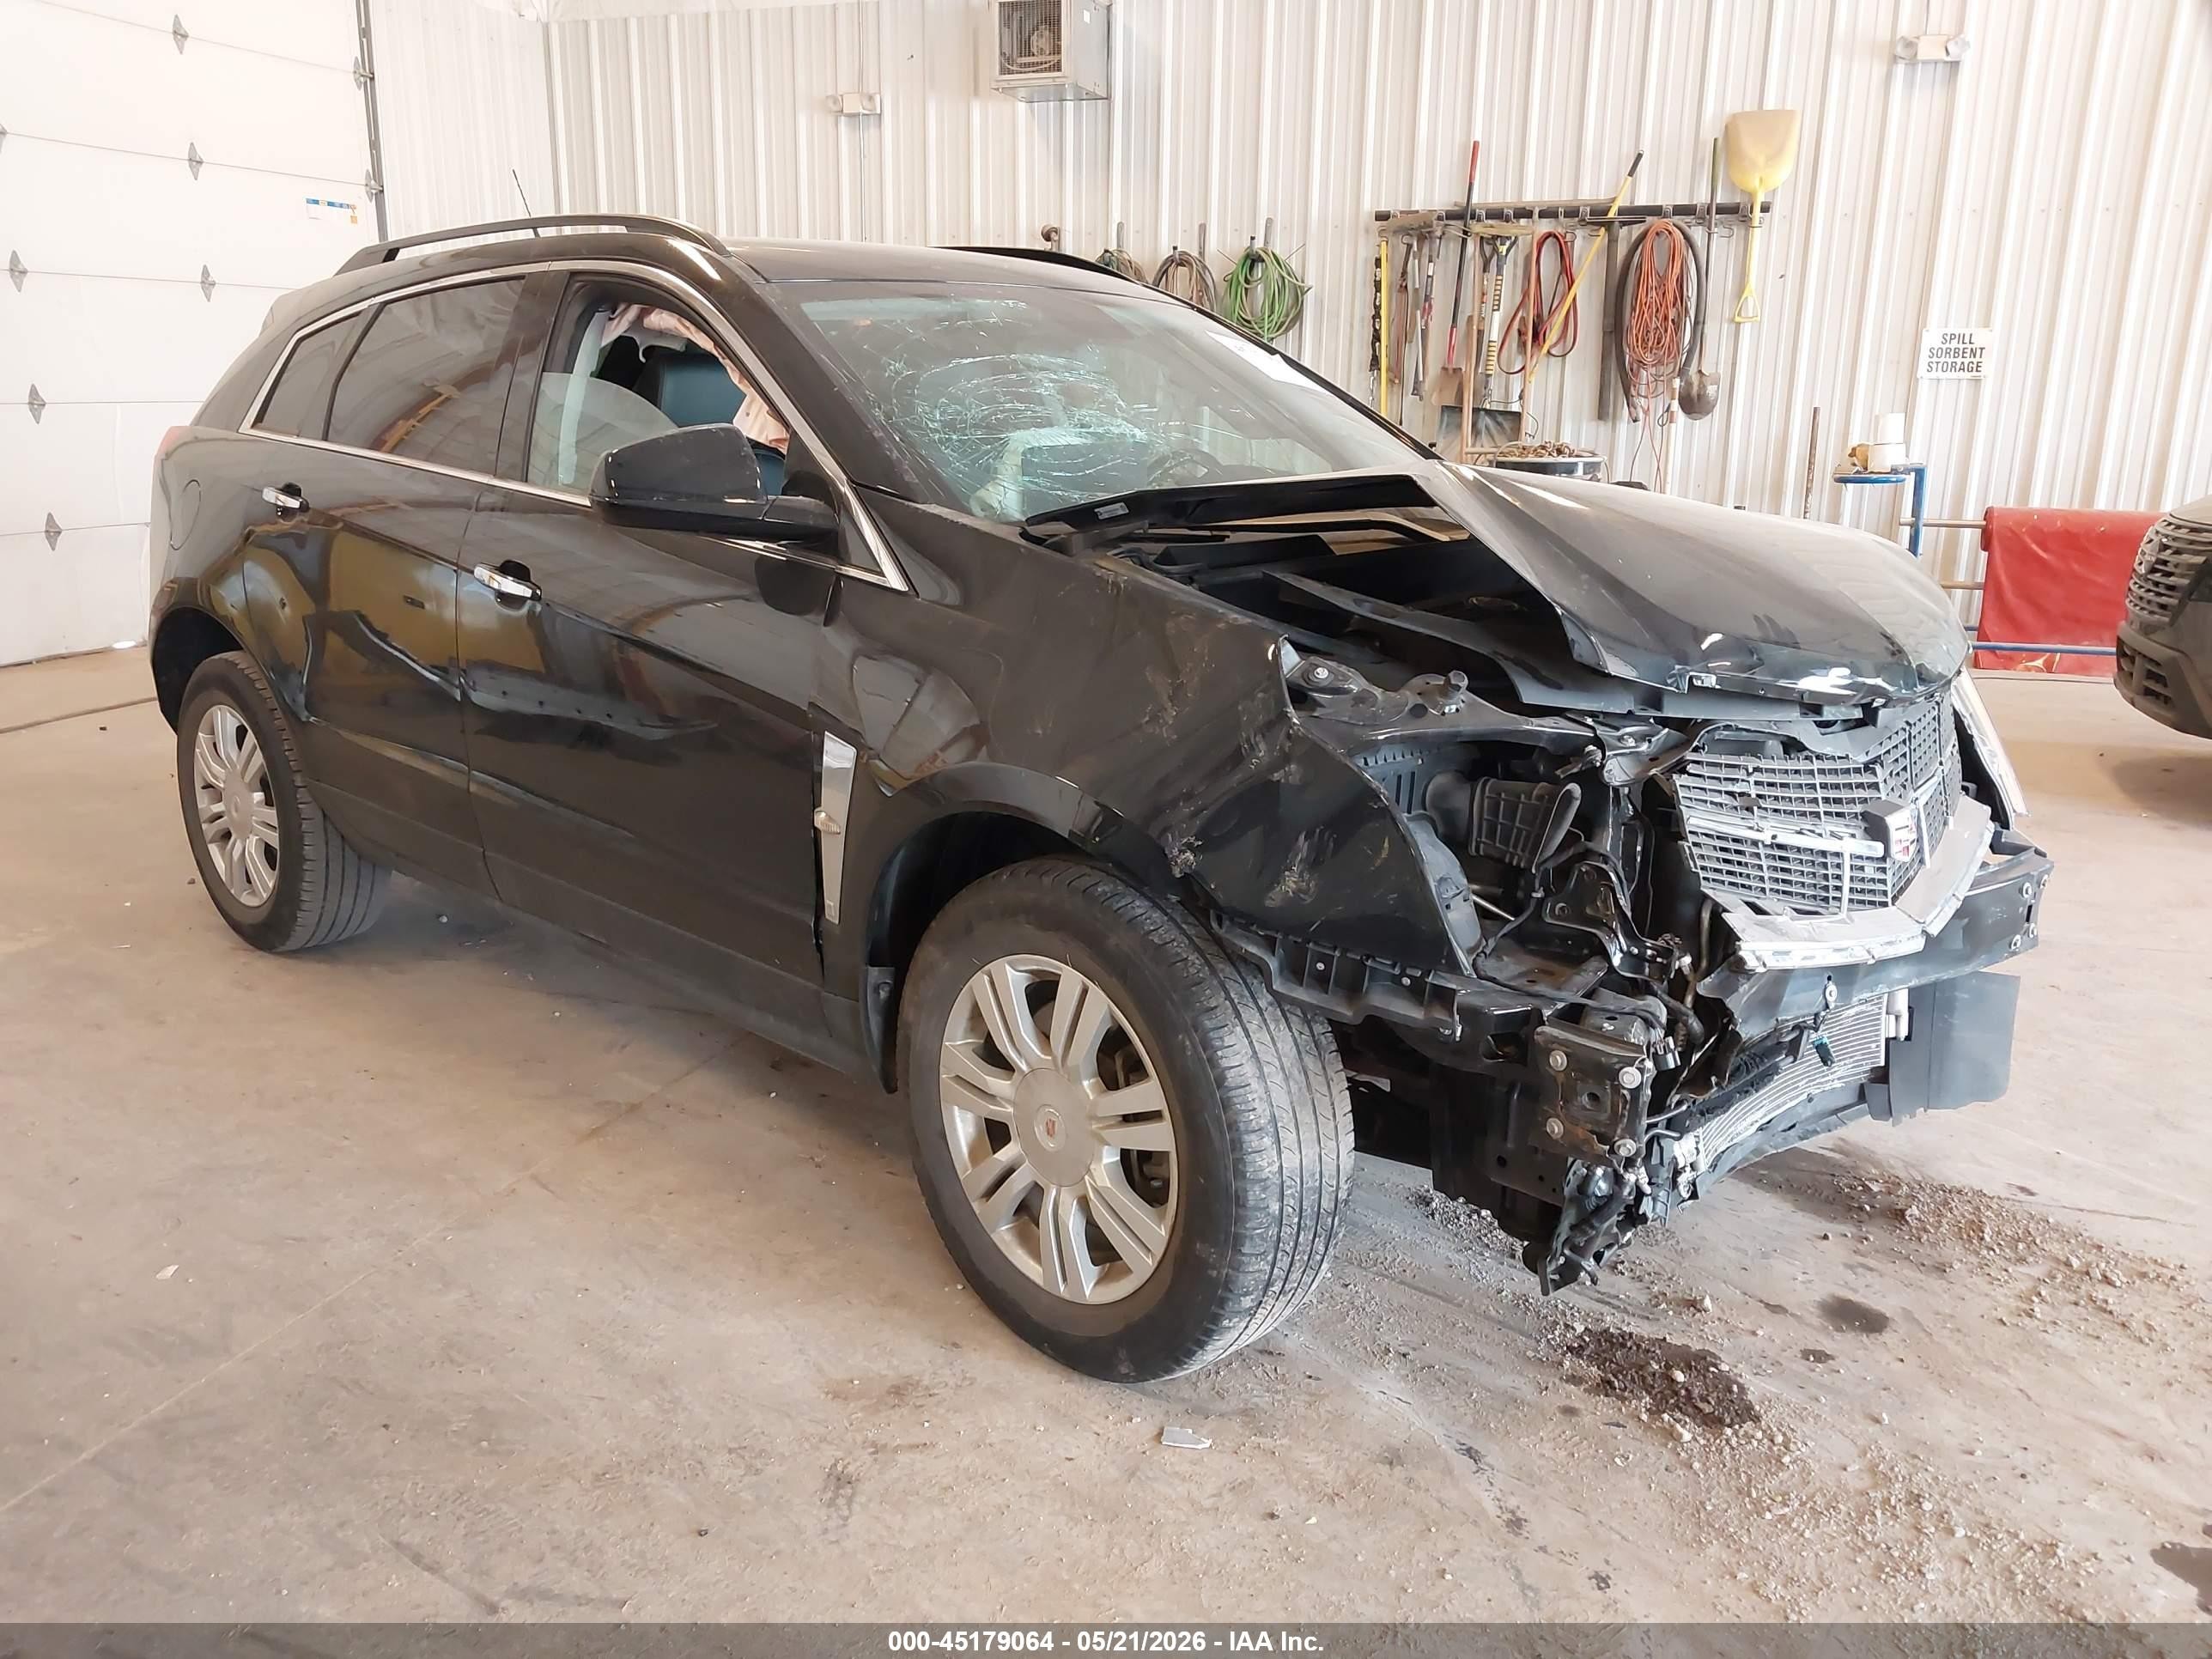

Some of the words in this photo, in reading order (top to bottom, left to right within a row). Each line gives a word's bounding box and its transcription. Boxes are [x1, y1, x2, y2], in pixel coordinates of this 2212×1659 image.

[1941, 332, 1975, 345] SPILL
[1928, 346, 1986, 359] SORBENT
[1926, 361, 1984, 373] STORAGE
